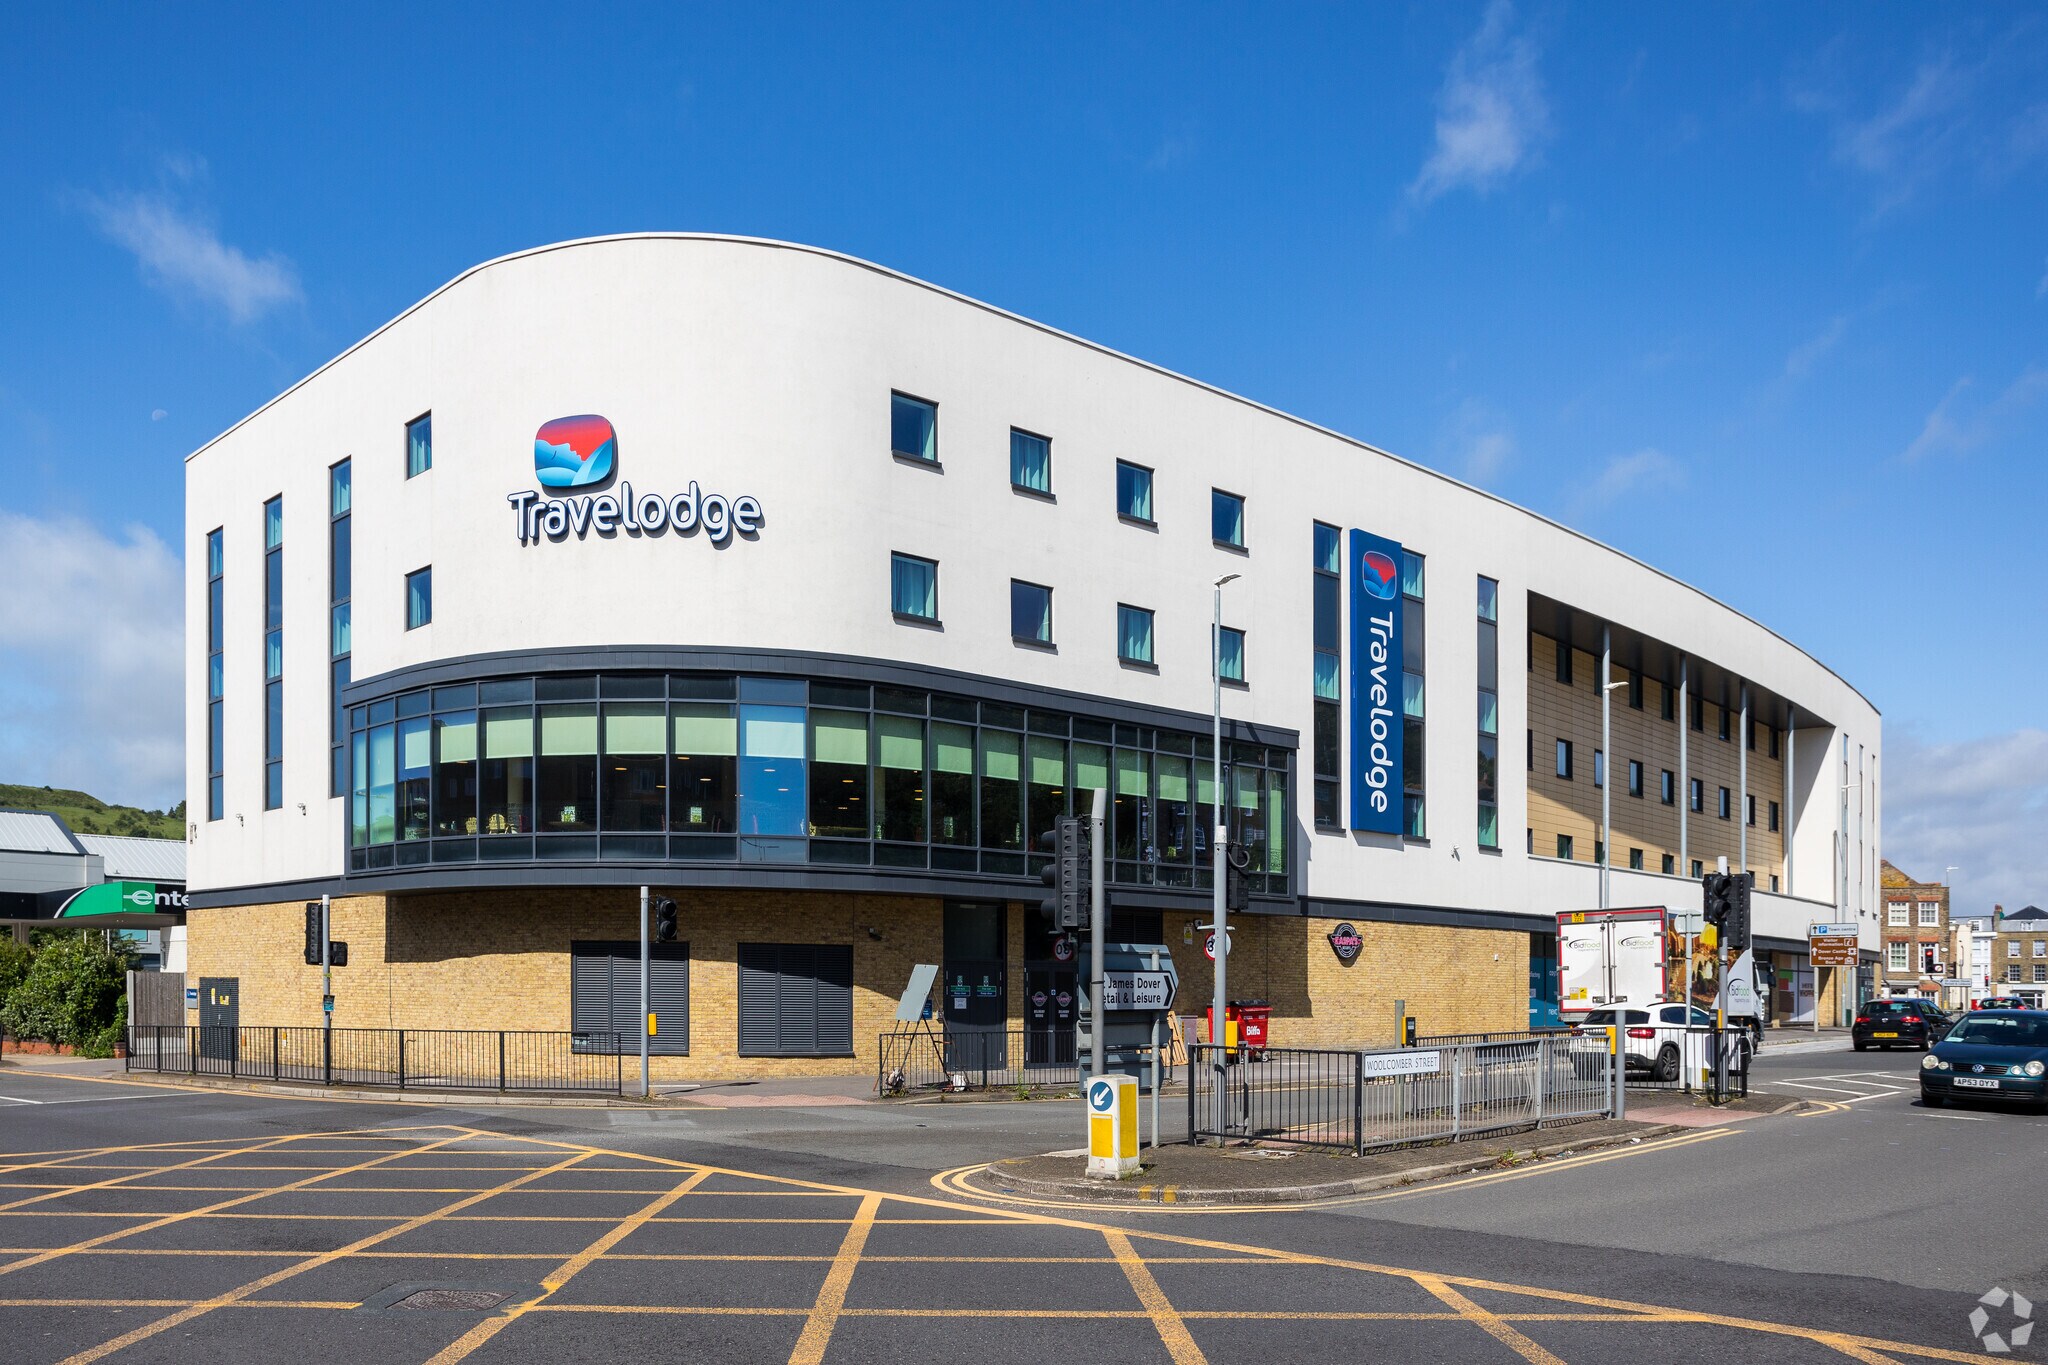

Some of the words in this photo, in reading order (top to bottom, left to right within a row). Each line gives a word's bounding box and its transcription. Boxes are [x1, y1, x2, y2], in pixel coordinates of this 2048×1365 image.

[507, 481, 762, 543] Travelodge
[1365, 611, 1393, 813] Travelodge
[1207, 940, 1214, 952] 3
[1573, 941, 1600, 949] Bidfood
[1626, 939, 1654, 947] Bidfood
[1108, 977, 1134, 989] James
[1137, 977, 1161, 989] Dover
[1103, 992, 1120, 1004] etail
[1123, 993, 1129, 1003] &
[1132, 992, 1161, 1003] Leisure
[1246, 1025, 1260, 1035] Biffa
[1366, 1058, 1412, 1071] WOOLCOMBER
[1415, 1056, 1438, 1068] STREET
[1957, 1078, 1978, 1087] AP53
